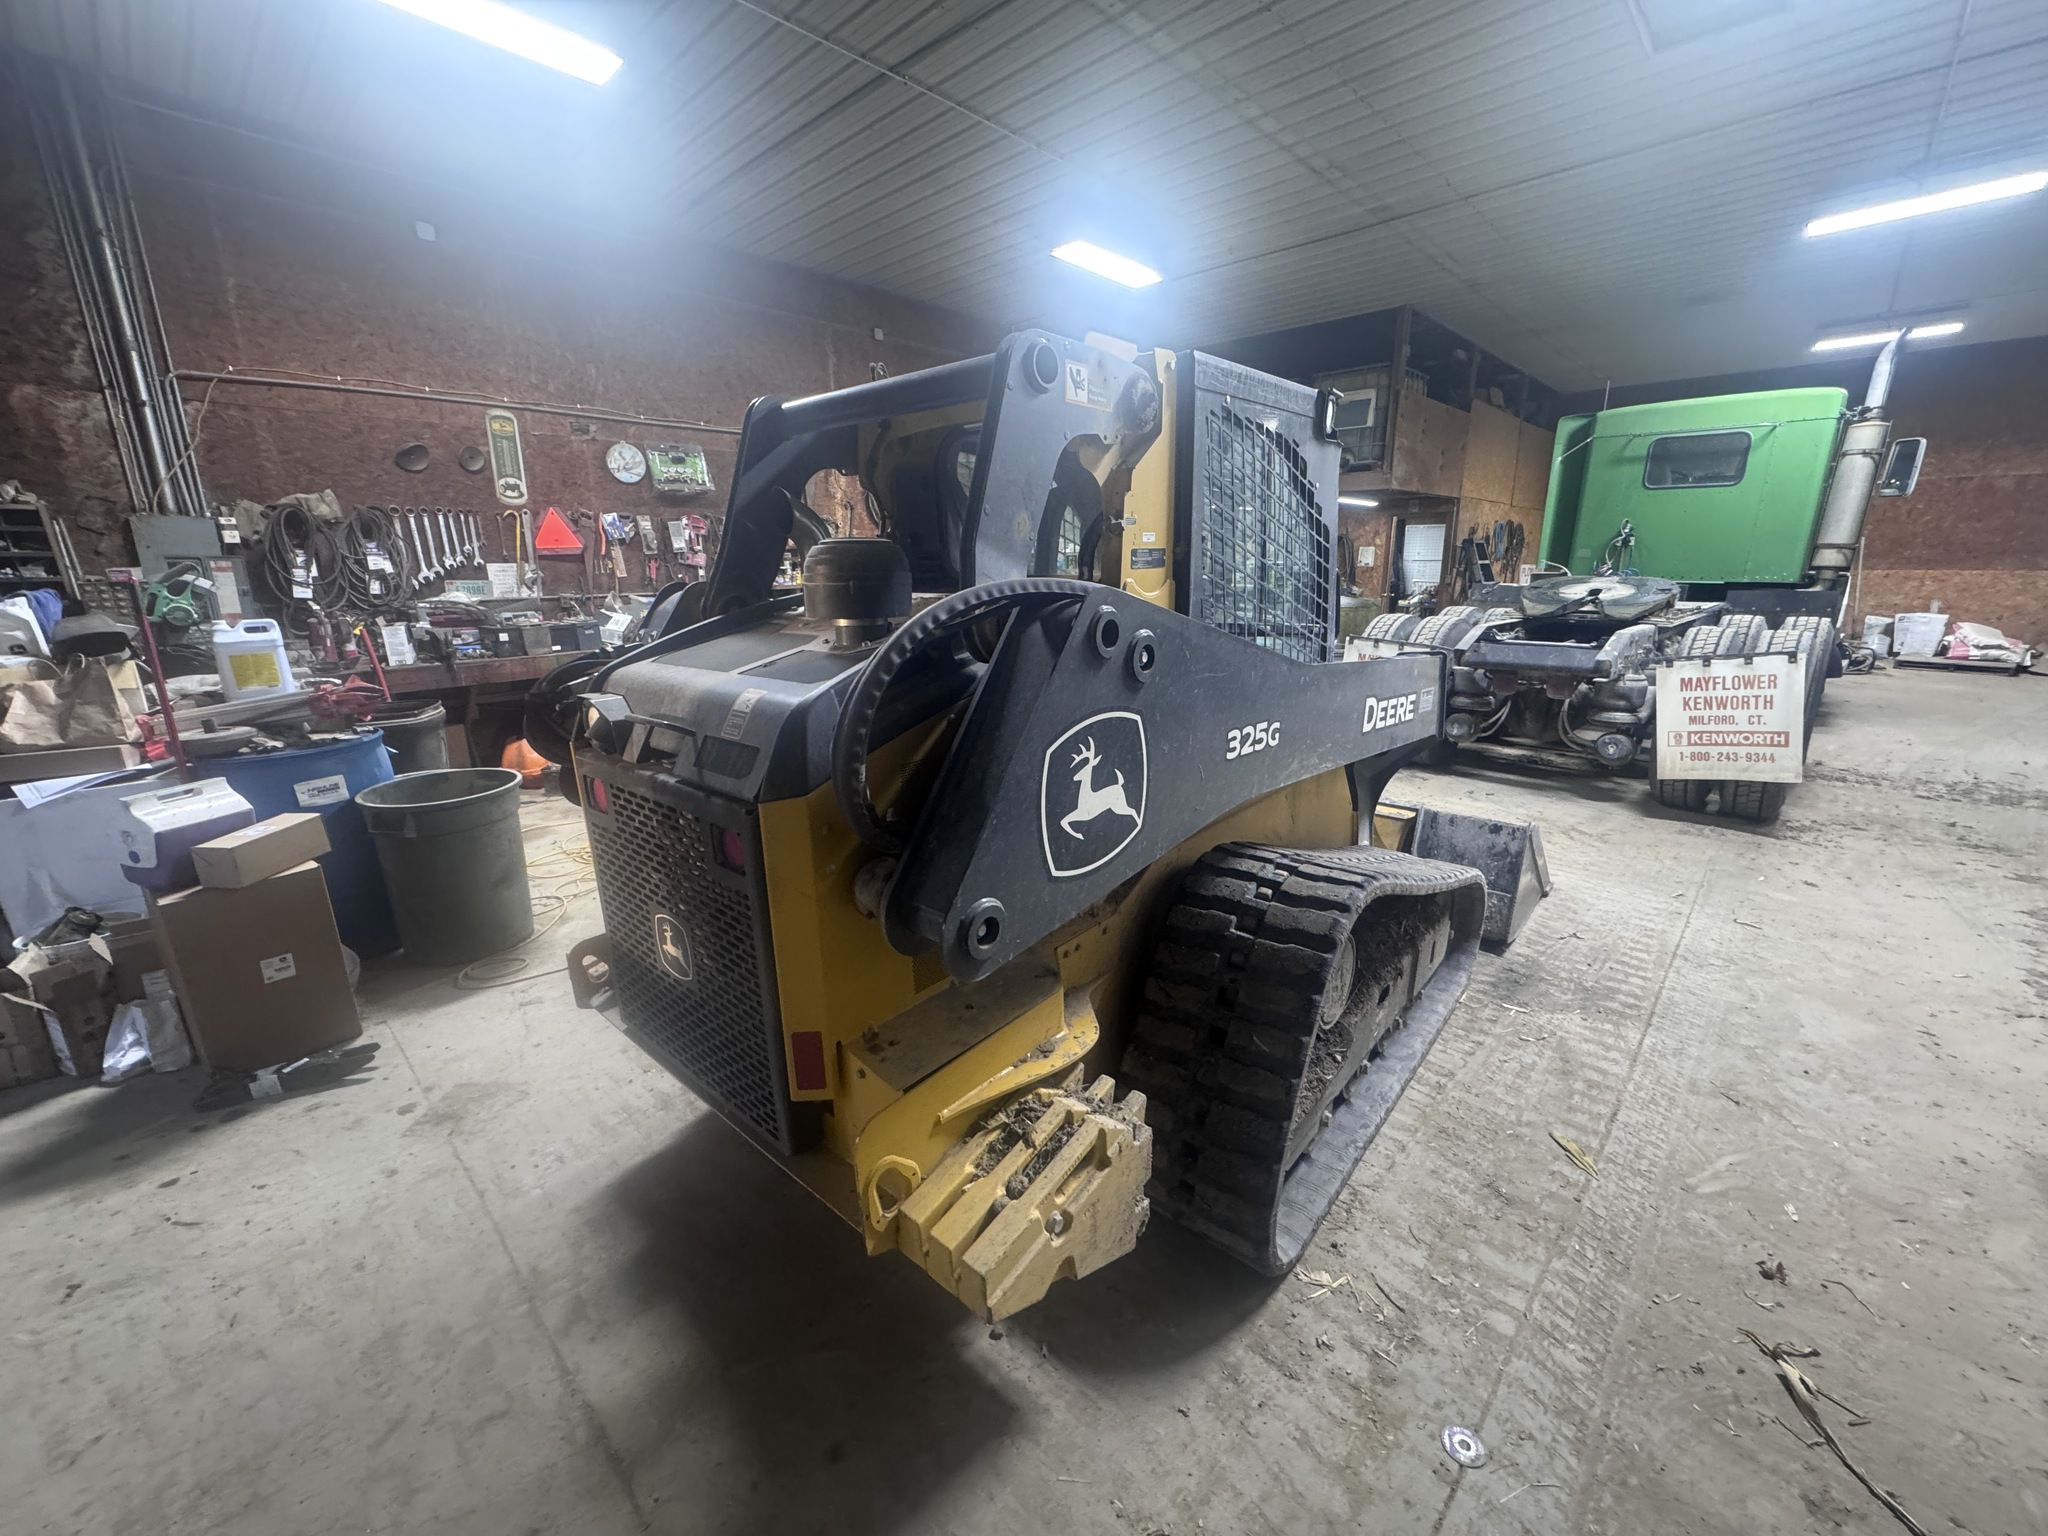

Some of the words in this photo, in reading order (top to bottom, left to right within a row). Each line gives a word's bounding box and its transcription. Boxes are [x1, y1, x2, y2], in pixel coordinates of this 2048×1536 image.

[1680, 674, 1778, 692] MAYFLOWER
[1682, 694, 1774, 711] KENWORTH
[1362, 693, 1417, 733] DEERE
[1688, 715, 1739, 726] MILFORD,
[1748, 715, 1767, 725] CT.
[1226, 721, 1281, 760] 325G
[1690, 733, 1786, 745] KENWORTH
[1679, 751, 1776, 763] 1-800-243-9344
